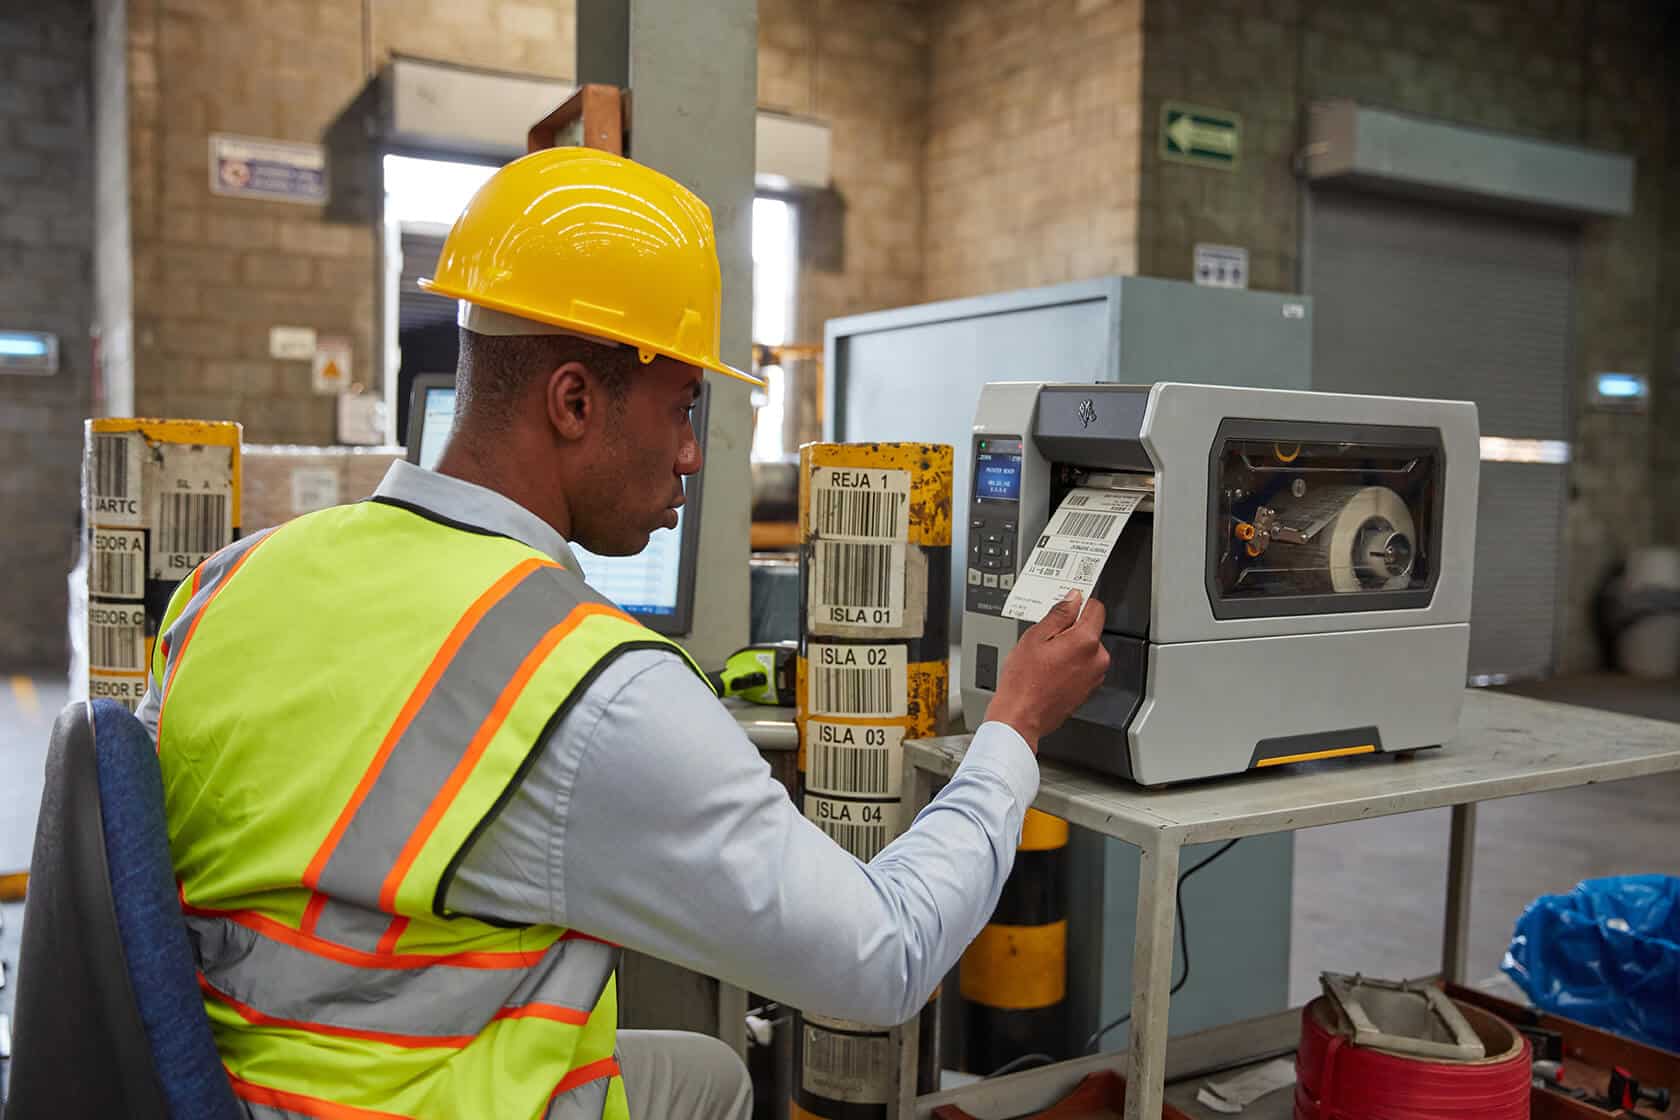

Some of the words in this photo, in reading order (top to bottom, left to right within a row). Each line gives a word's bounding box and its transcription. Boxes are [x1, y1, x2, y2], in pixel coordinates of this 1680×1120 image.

[831, 472, 871, 489] REJA
[881, 474, 888, 489] 1
[131, 537, 142, 552] A
[830, 608, 867, 623] ISLA
[873, 610, 890, 624] 01
[820, 648, 856, 665] ISLA
[867, 649, 887, 666] 02
[134, 682, 144, 697] E
[819, 725, 855, 745] ISLA
[865, 729, 885, 746] 03
[816, 800, 851, 821] ISLA
[862, 806, 882, 823] 04
